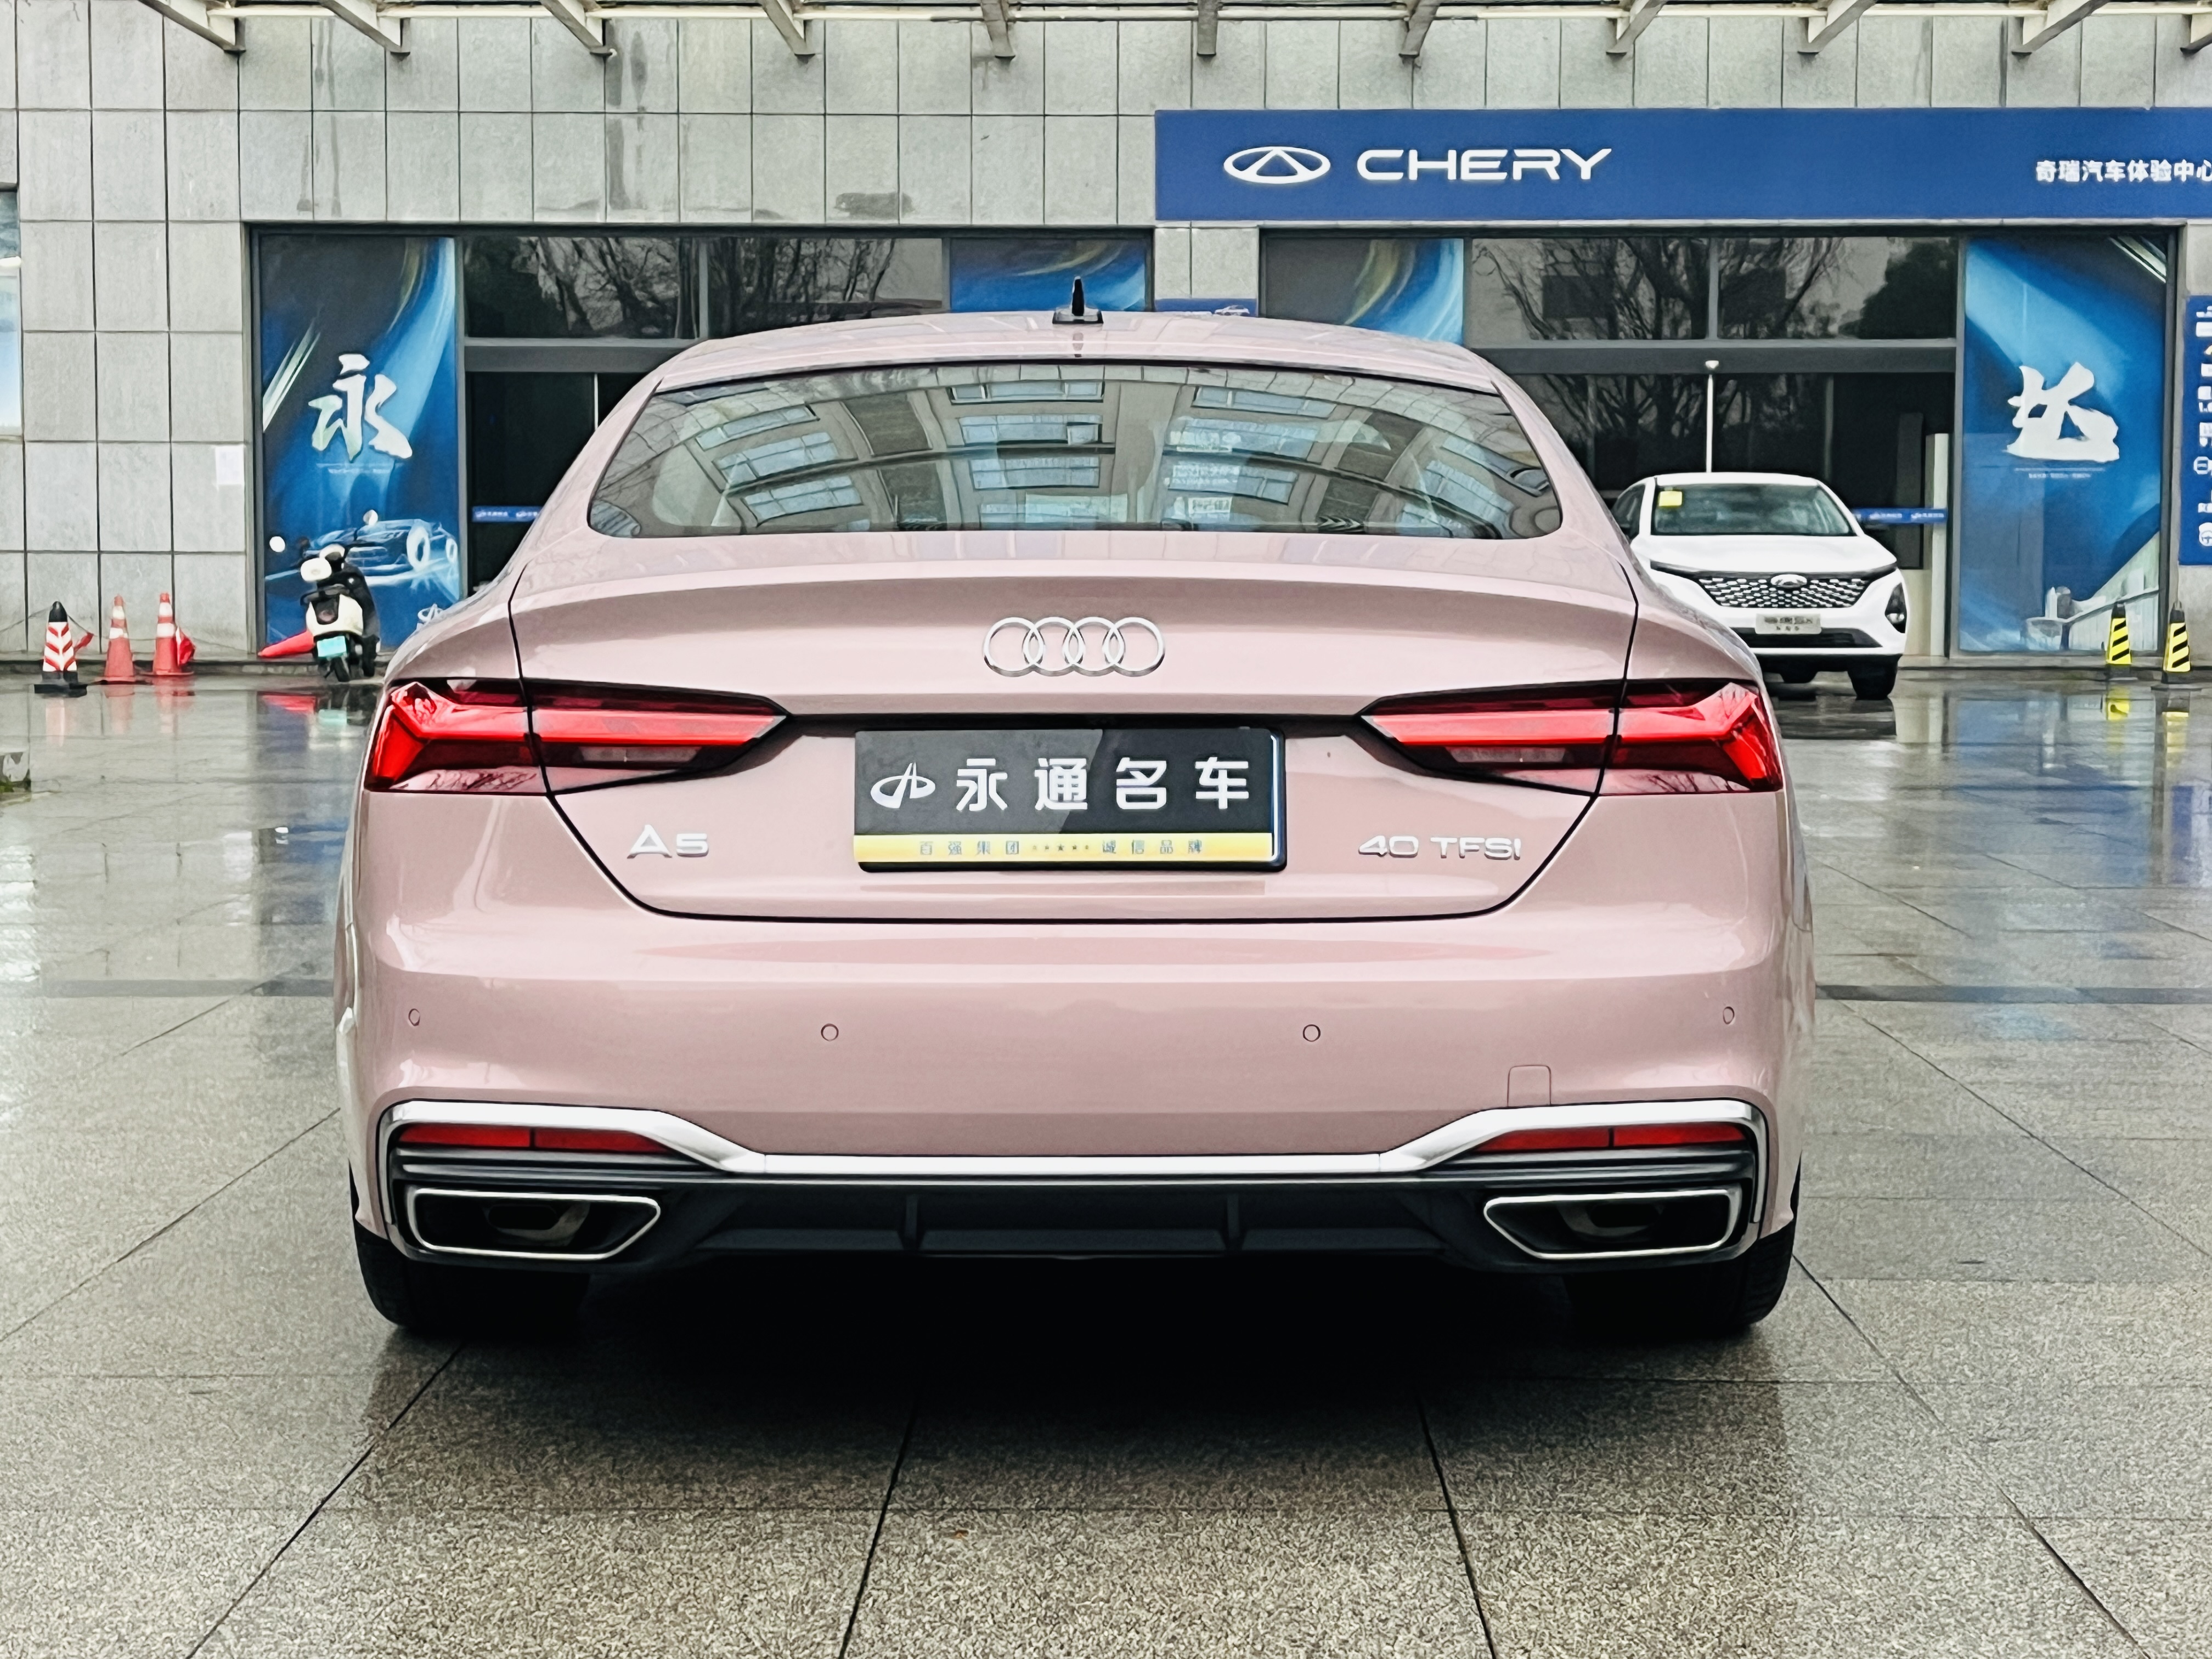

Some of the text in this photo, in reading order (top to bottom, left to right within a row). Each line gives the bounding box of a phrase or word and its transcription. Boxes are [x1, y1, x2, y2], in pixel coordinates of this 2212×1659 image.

[1357, 148, 1612, 180] CHERY
[2036, 159, 2212, 183] 奇瑞汽车体验中心
[308, 353, 413, 462] 永
[956, 757, 1250, 812] 永通名车
[627, 824, 709, 859] A5
[1358, 835, 1521, 861] 40 TFSI
